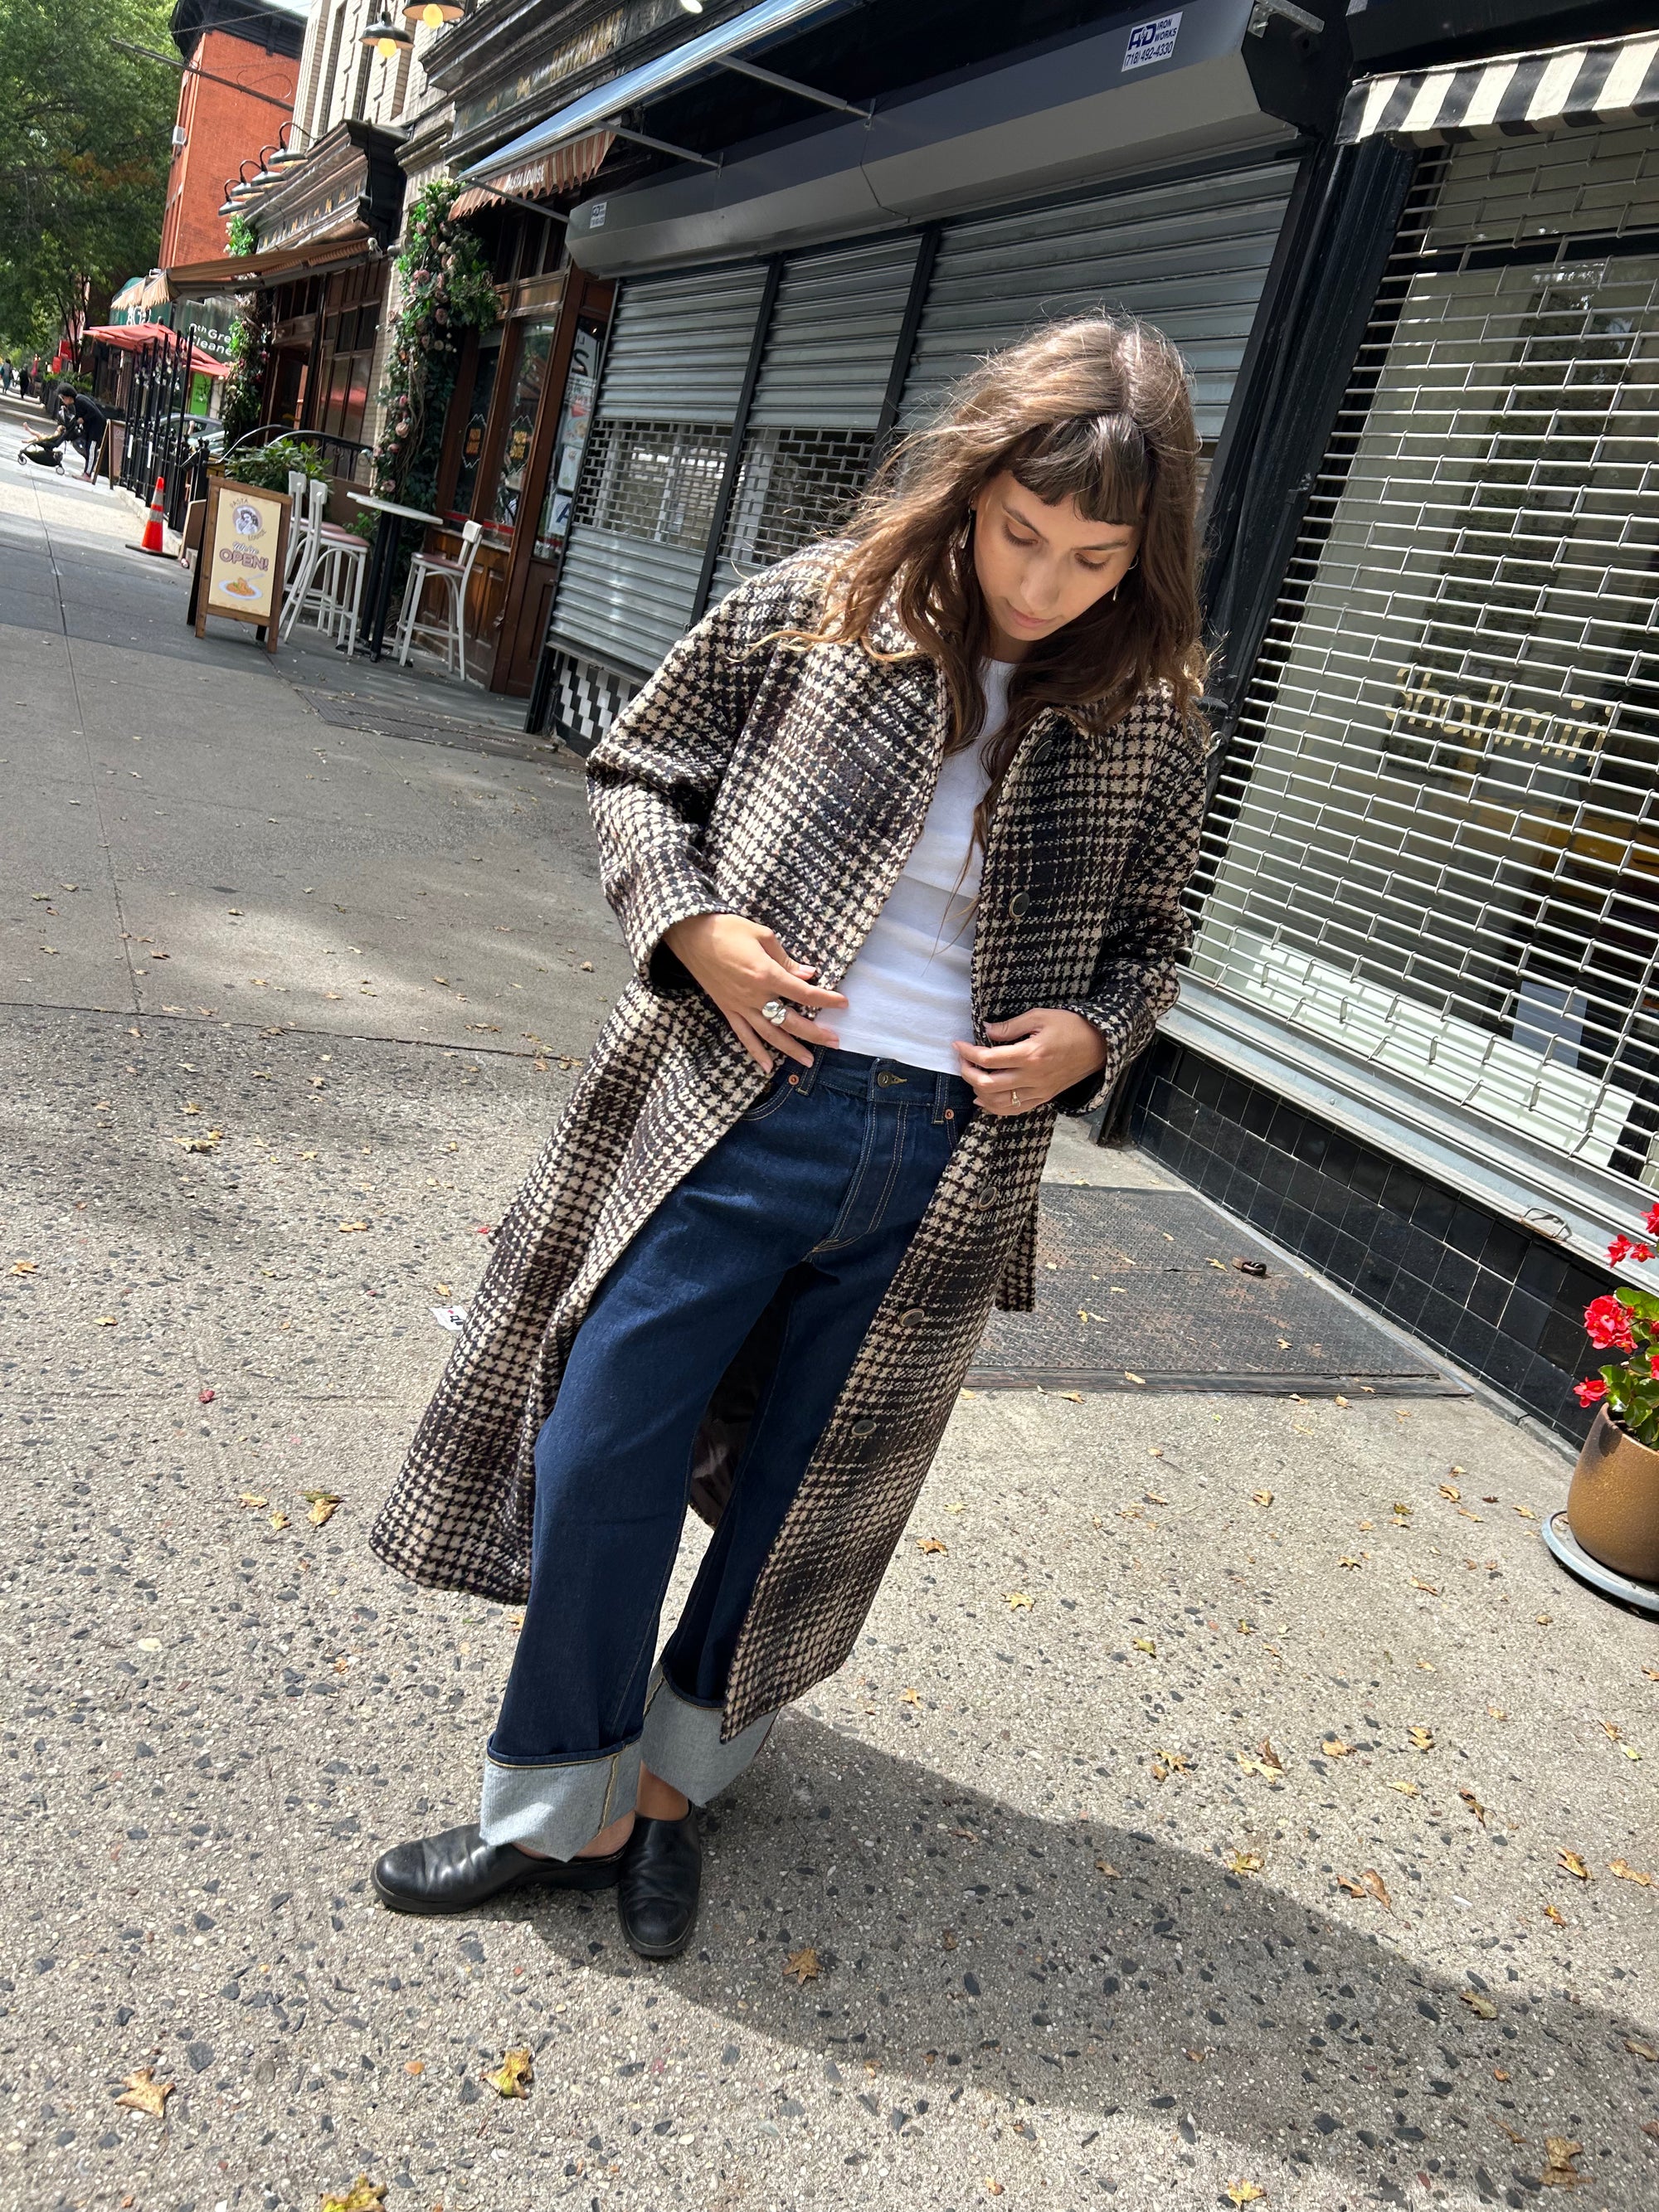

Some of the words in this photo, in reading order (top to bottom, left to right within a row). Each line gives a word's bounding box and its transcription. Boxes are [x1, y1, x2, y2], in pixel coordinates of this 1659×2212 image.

[1155, 27, 1177, 41] WORKS
[1157, 19, 1172, 31] IRON
[1125, 51, 1141, 66] (718)
[1141, 41, 1174, 61] 492-4330
[523, 163, 545, 187] LOUISE
[187, 335, 232, 357] Cleane
[208, 328, 231, 344] Gre
[219, 548, 269, 571] OPEN!
